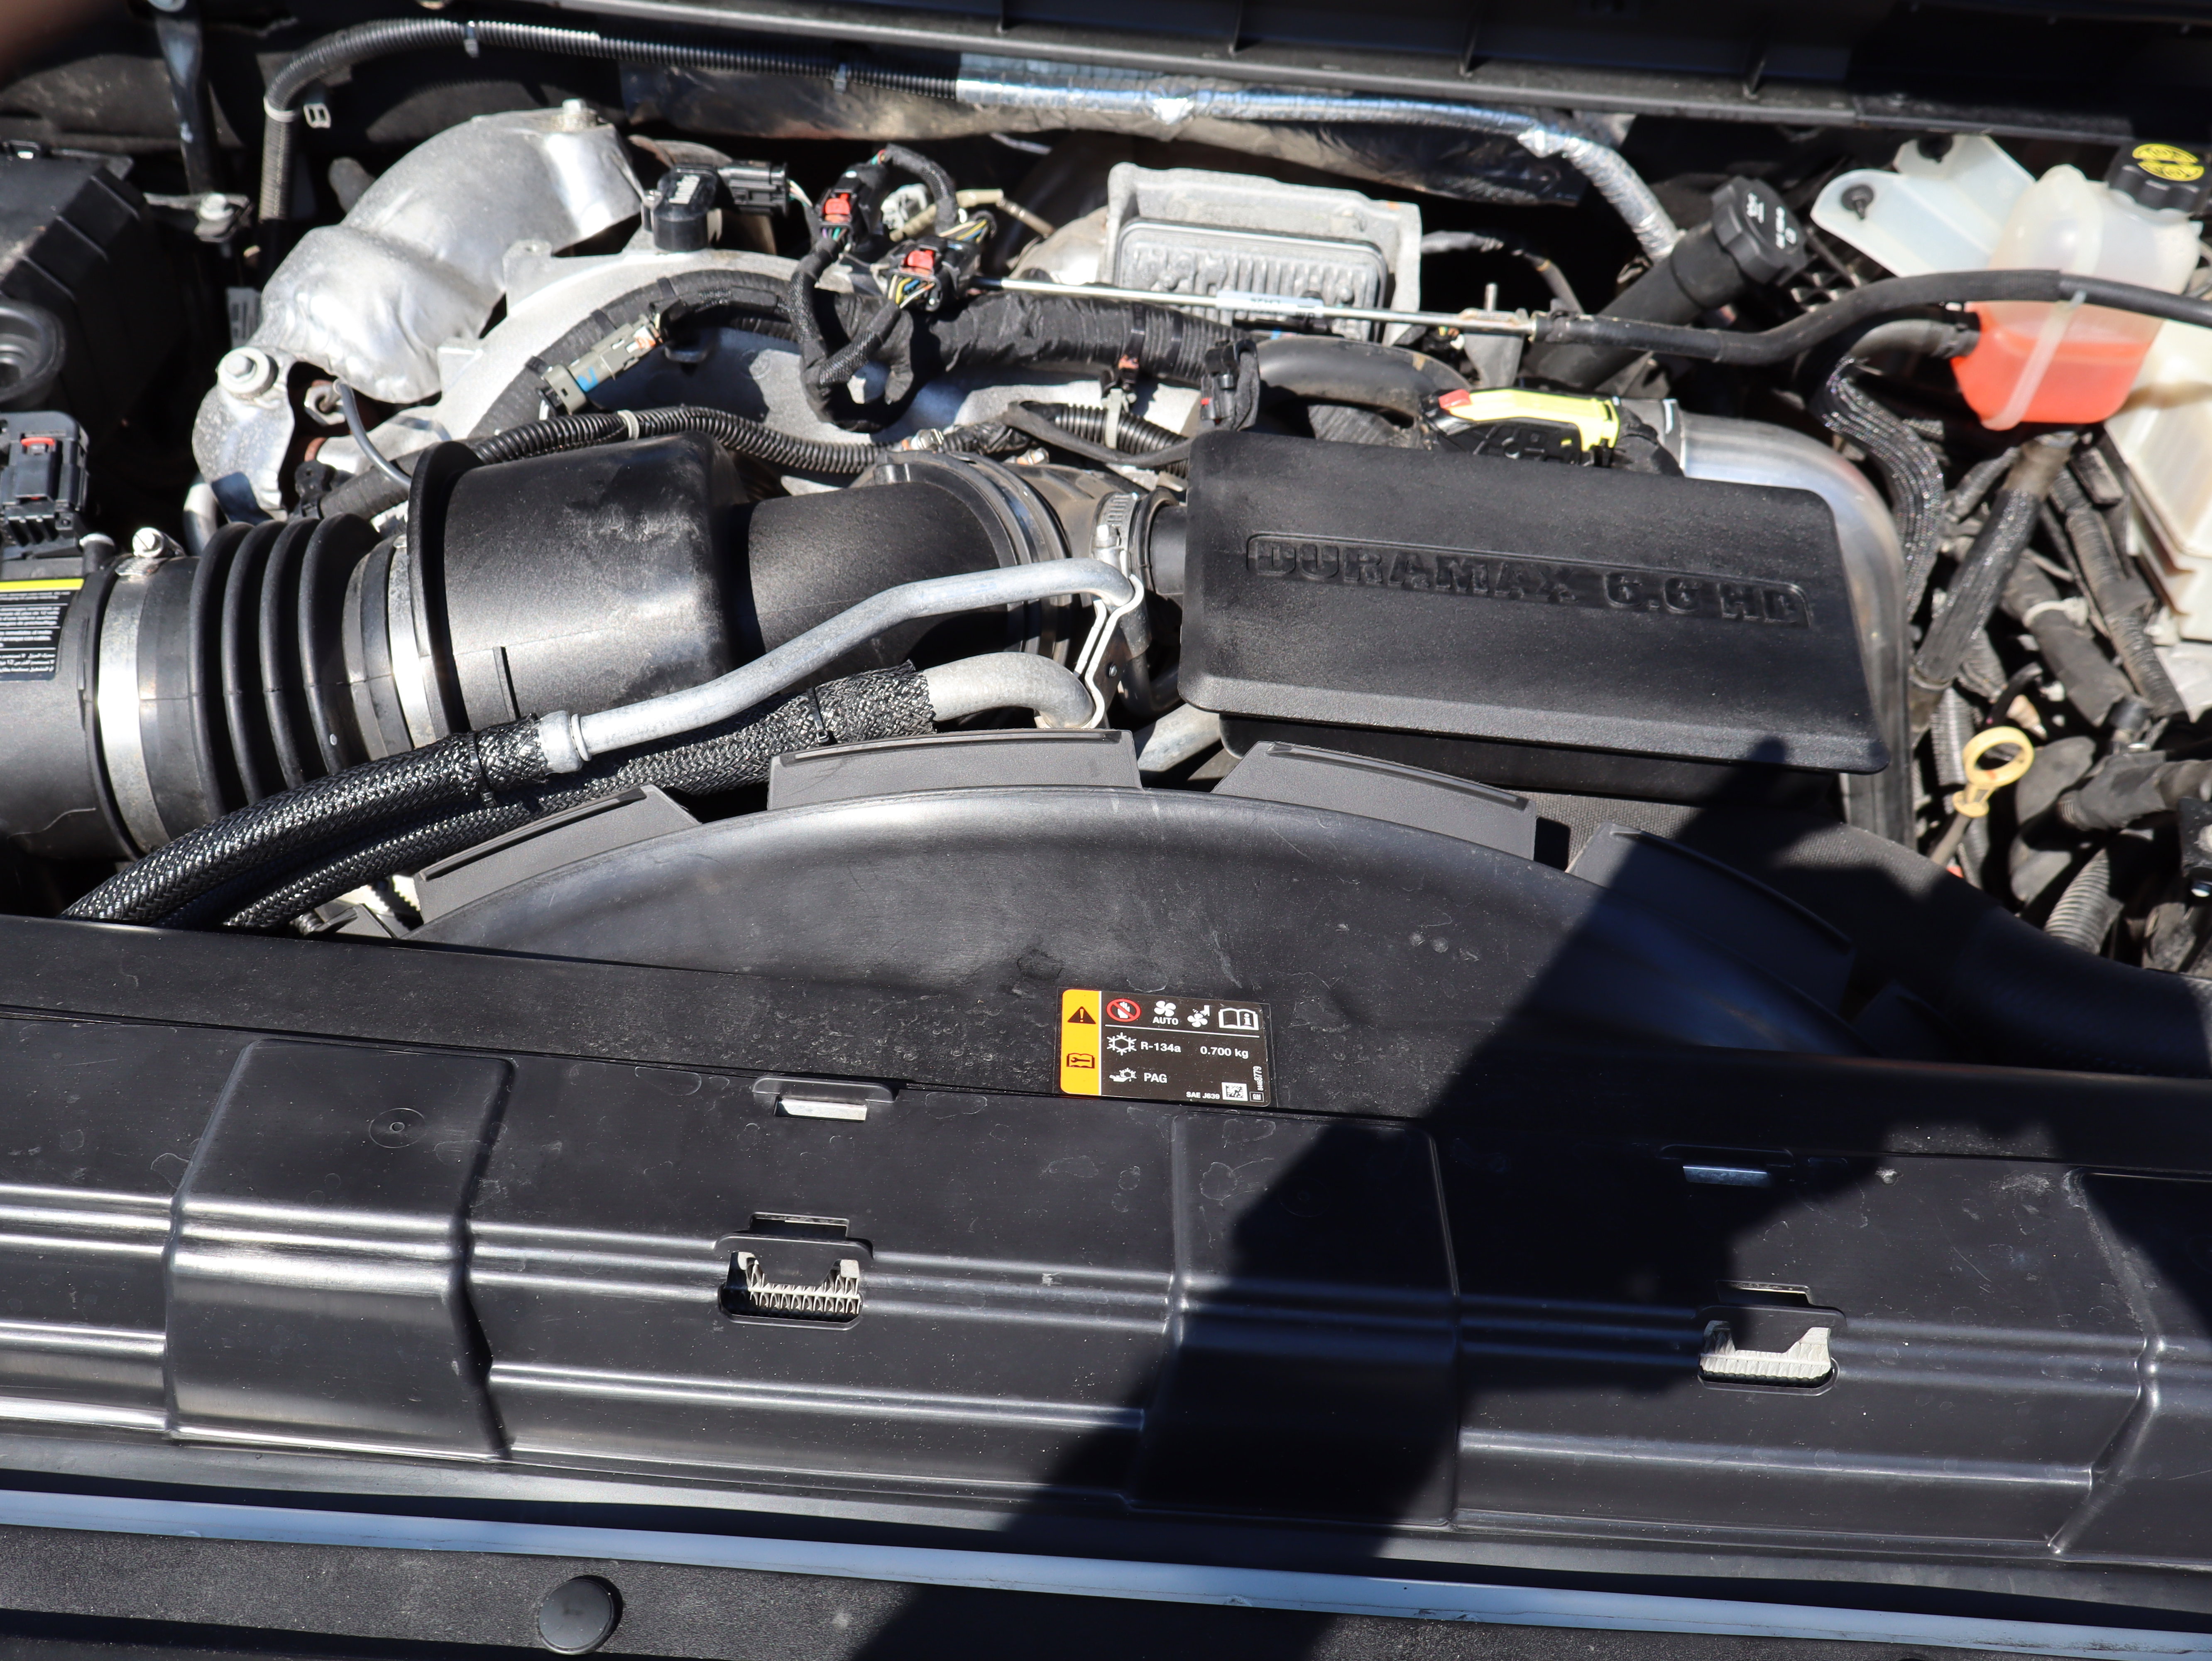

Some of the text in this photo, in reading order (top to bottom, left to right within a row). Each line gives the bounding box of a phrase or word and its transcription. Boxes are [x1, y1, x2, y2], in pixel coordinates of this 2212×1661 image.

[1255, 541, 1802, 625] DURAMAX 6.6 HD
[1152, 1017, 1179, 1025] AUTO
[1140, 1041, 1249, 1059] R-134a 0.700 kg
[1144, 1073, 1167, 1083] PAG
